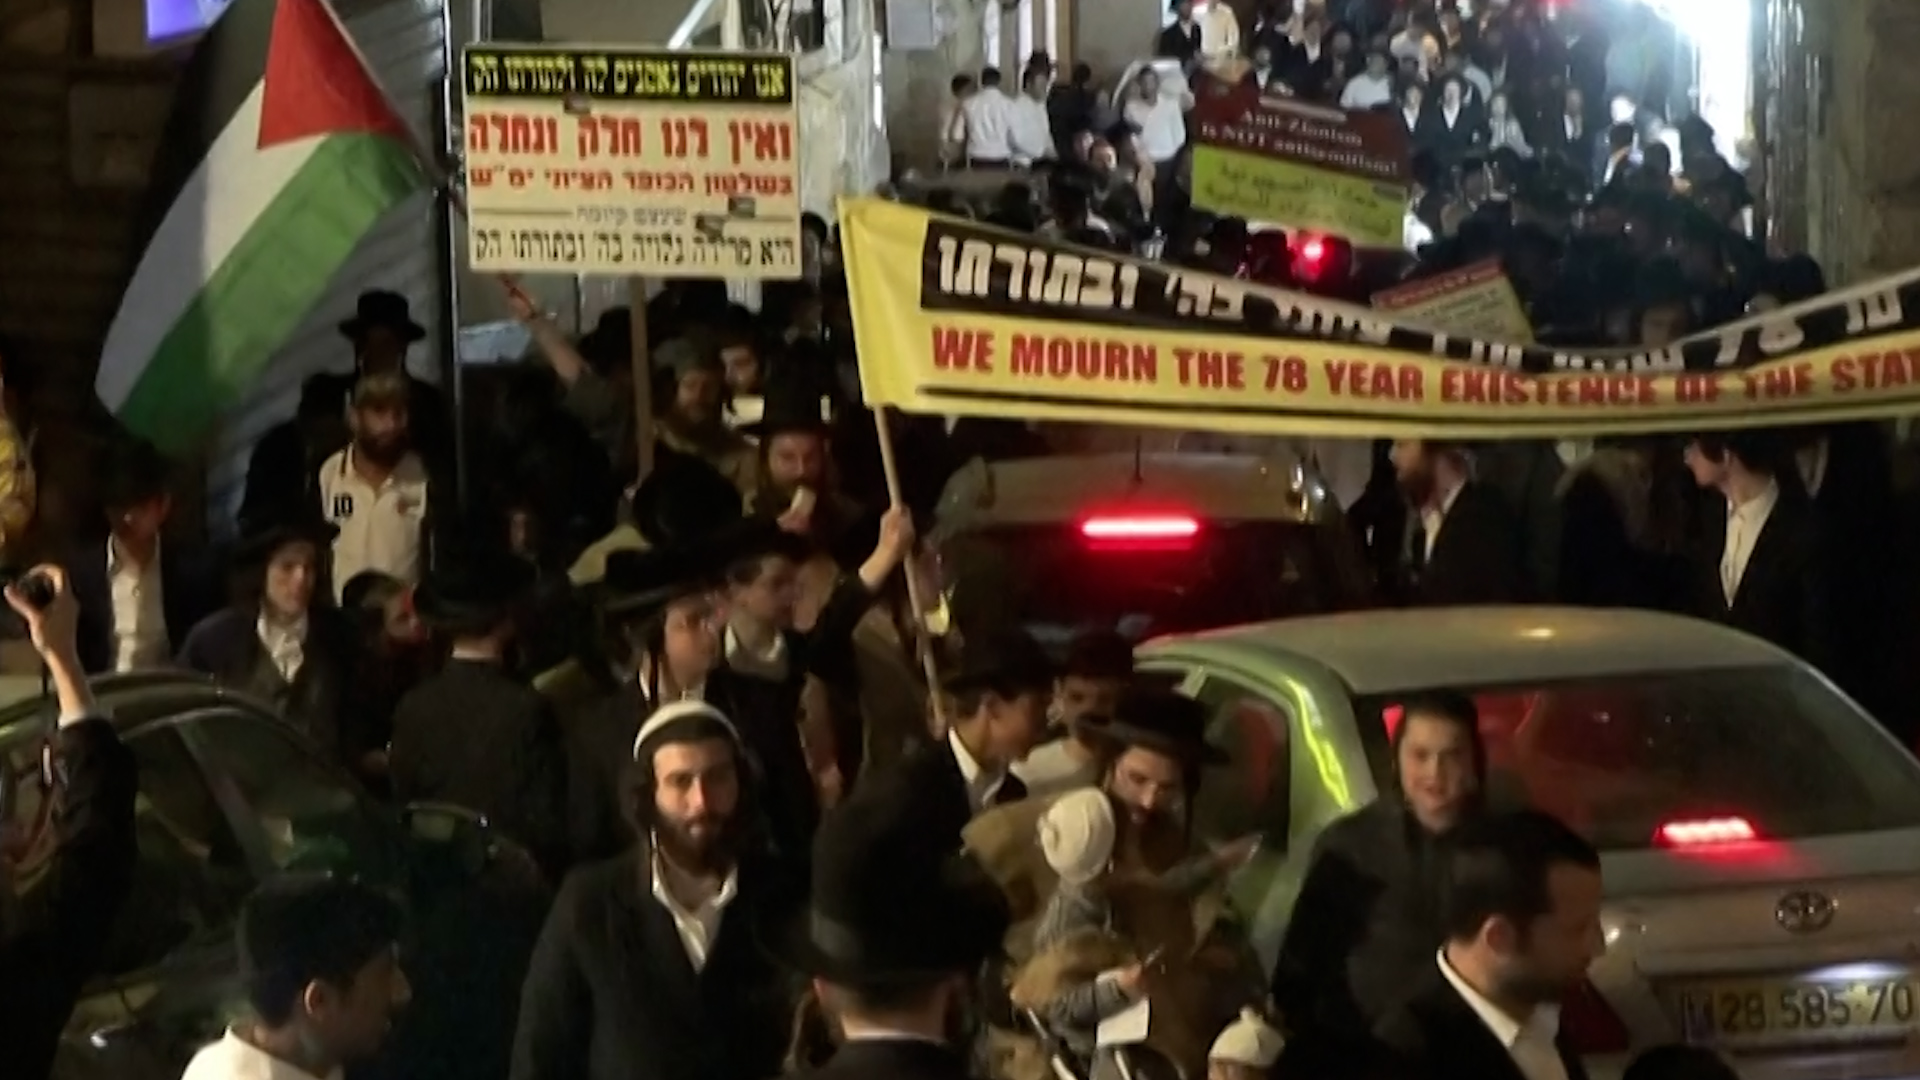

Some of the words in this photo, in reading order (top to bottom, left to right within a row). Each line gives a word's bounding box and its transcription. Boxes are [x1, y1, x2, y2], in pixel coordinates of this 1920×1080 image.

[686, 60, 746, 97] יהודים
[752, 63, 785, 97] אנו
[470, 113, 558, 154] ונחלה
[578, 114, 641, 160] חלק
[661, 117, 708, 157] לנו
[728, 121, 791, 165] ואין
[544, 168, 613, 190] הציוני
[622, 171, 694, 193] הכופר
[704, 173, 792, 196] בשלטון
[510, 229, 586, 261] ובתורתו
[633, 232, 684, 264] גלויה
[761, 238, 794, 266] היא
[938, 235, 1140, 310] ובתורתו
[933, 326, 995, 372] WE
[1011, 333, 1157, 384] MOURN
[1173, 347, 1245, 392] THE
[1262, 354, 1307, 394] 78
[1324, 358, 1424, 402] YEAR
[1441, 363, 1656, 405] EXISTENCE
[1675, 370, 1721, 403] OF
[1738, 362, 1814, 402] THE
